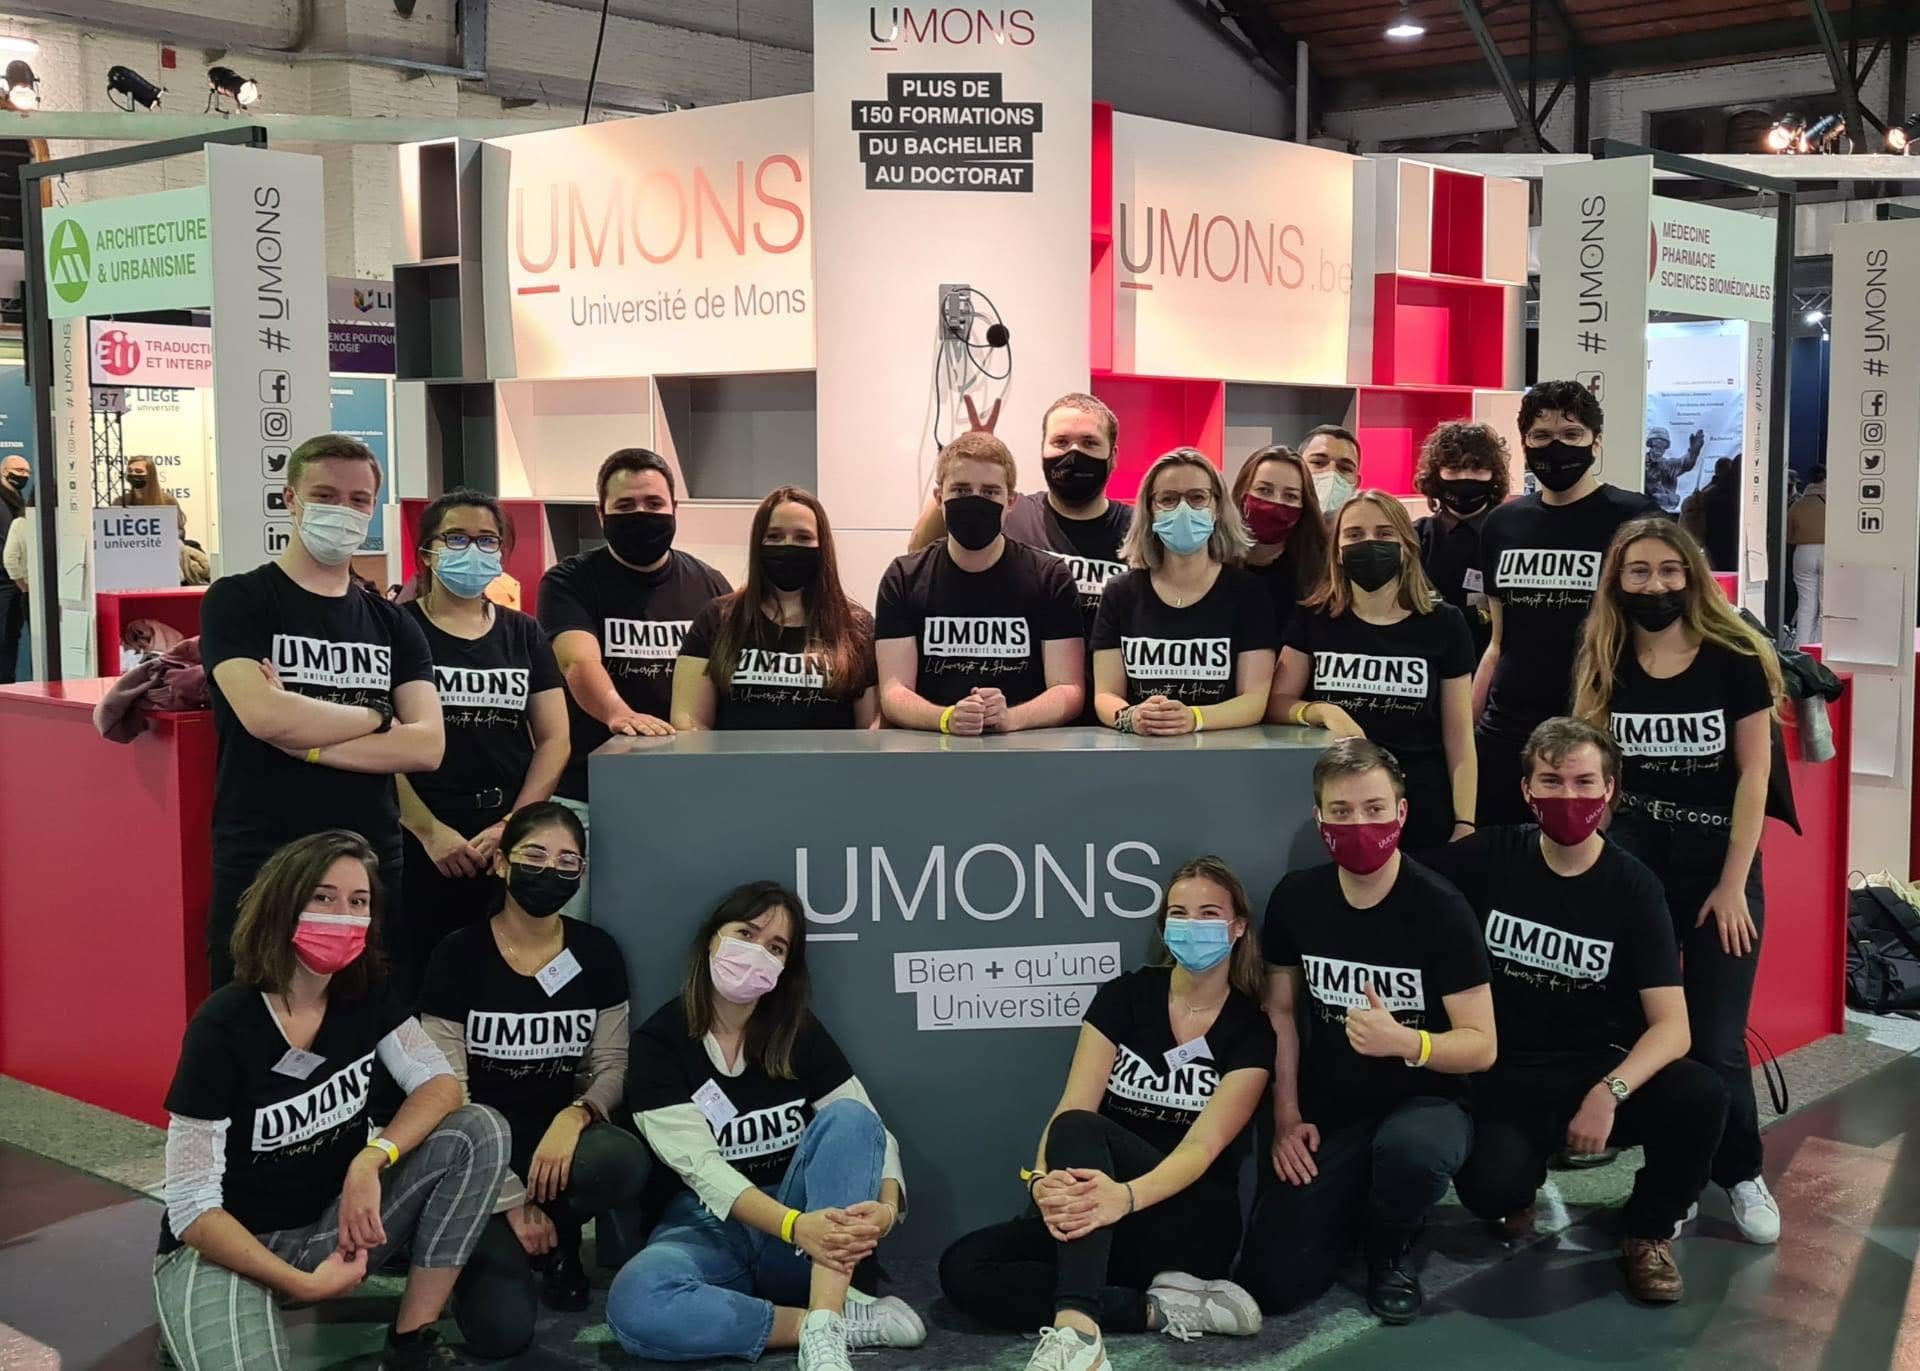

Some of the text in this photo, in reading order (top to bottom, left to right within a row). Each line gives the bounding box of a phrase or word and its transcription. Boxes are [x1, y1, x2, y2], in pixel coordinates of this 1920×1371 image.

[870, 7, 1035, 50] UMONS
[902, 80, 990, 97] PLUS DE
[859, 106, 1035, 125] 150 FORMATIONS
[869, 136, 1022, 155] DU BACHELIER
[875, 166, 1024, 185] AU DOCTORAT
[96, 218, 207, 250] ARCHITECTURE
[516, 154, 804, 295] UMONS
[1663, 220, 1710, 244] MÉDECINE
[98, 253, 196, 283] & URBANISME
[1662, 246, 1716, 269] PHARMACIE
[1661, 270, 1771, 300] SCIENCES BIOMÉDICALES
[570, 284, 806, 326] Université de Mons
[145, 340, 211, 354] TRADUCTI
[329, 333, 396, 344] ENCE POLITIQU
[329, 343, 360, 352] OLOGIE
[146, 357, 212, 370] ET INTERP
[100, 393, 119, 407] 57
[104, 514, 161, 537] LIÈGE
[104, 537, 162, 549] université
[1500, 553, 1596, 578] UMONS
[610, 621, 687, 647] UMON
[928, 620, 1026, 645] UMONS
[279, 638, 389, 676] UMONS
[737, 649, 825, 676] UMON
[1122, 640, 1227, 667] UMONS
[434, 669, 526, 697] MONS
[1316, 655, 1424, 685] UMONS
[1612, 714, 1722, 744] UMONS
[795, 841, 1164, 941] UMONS
[1489, 915, 1607, 971] UMONS
[908, 951, 1116, 985] Bien + qu'une
[1305, 959, 1417, 999] UMONS
[933, 992, 1081, 1026] Université
[471, 1014, 592, 1046] UMONS
[718, 1105, 801, 1148] MONS
